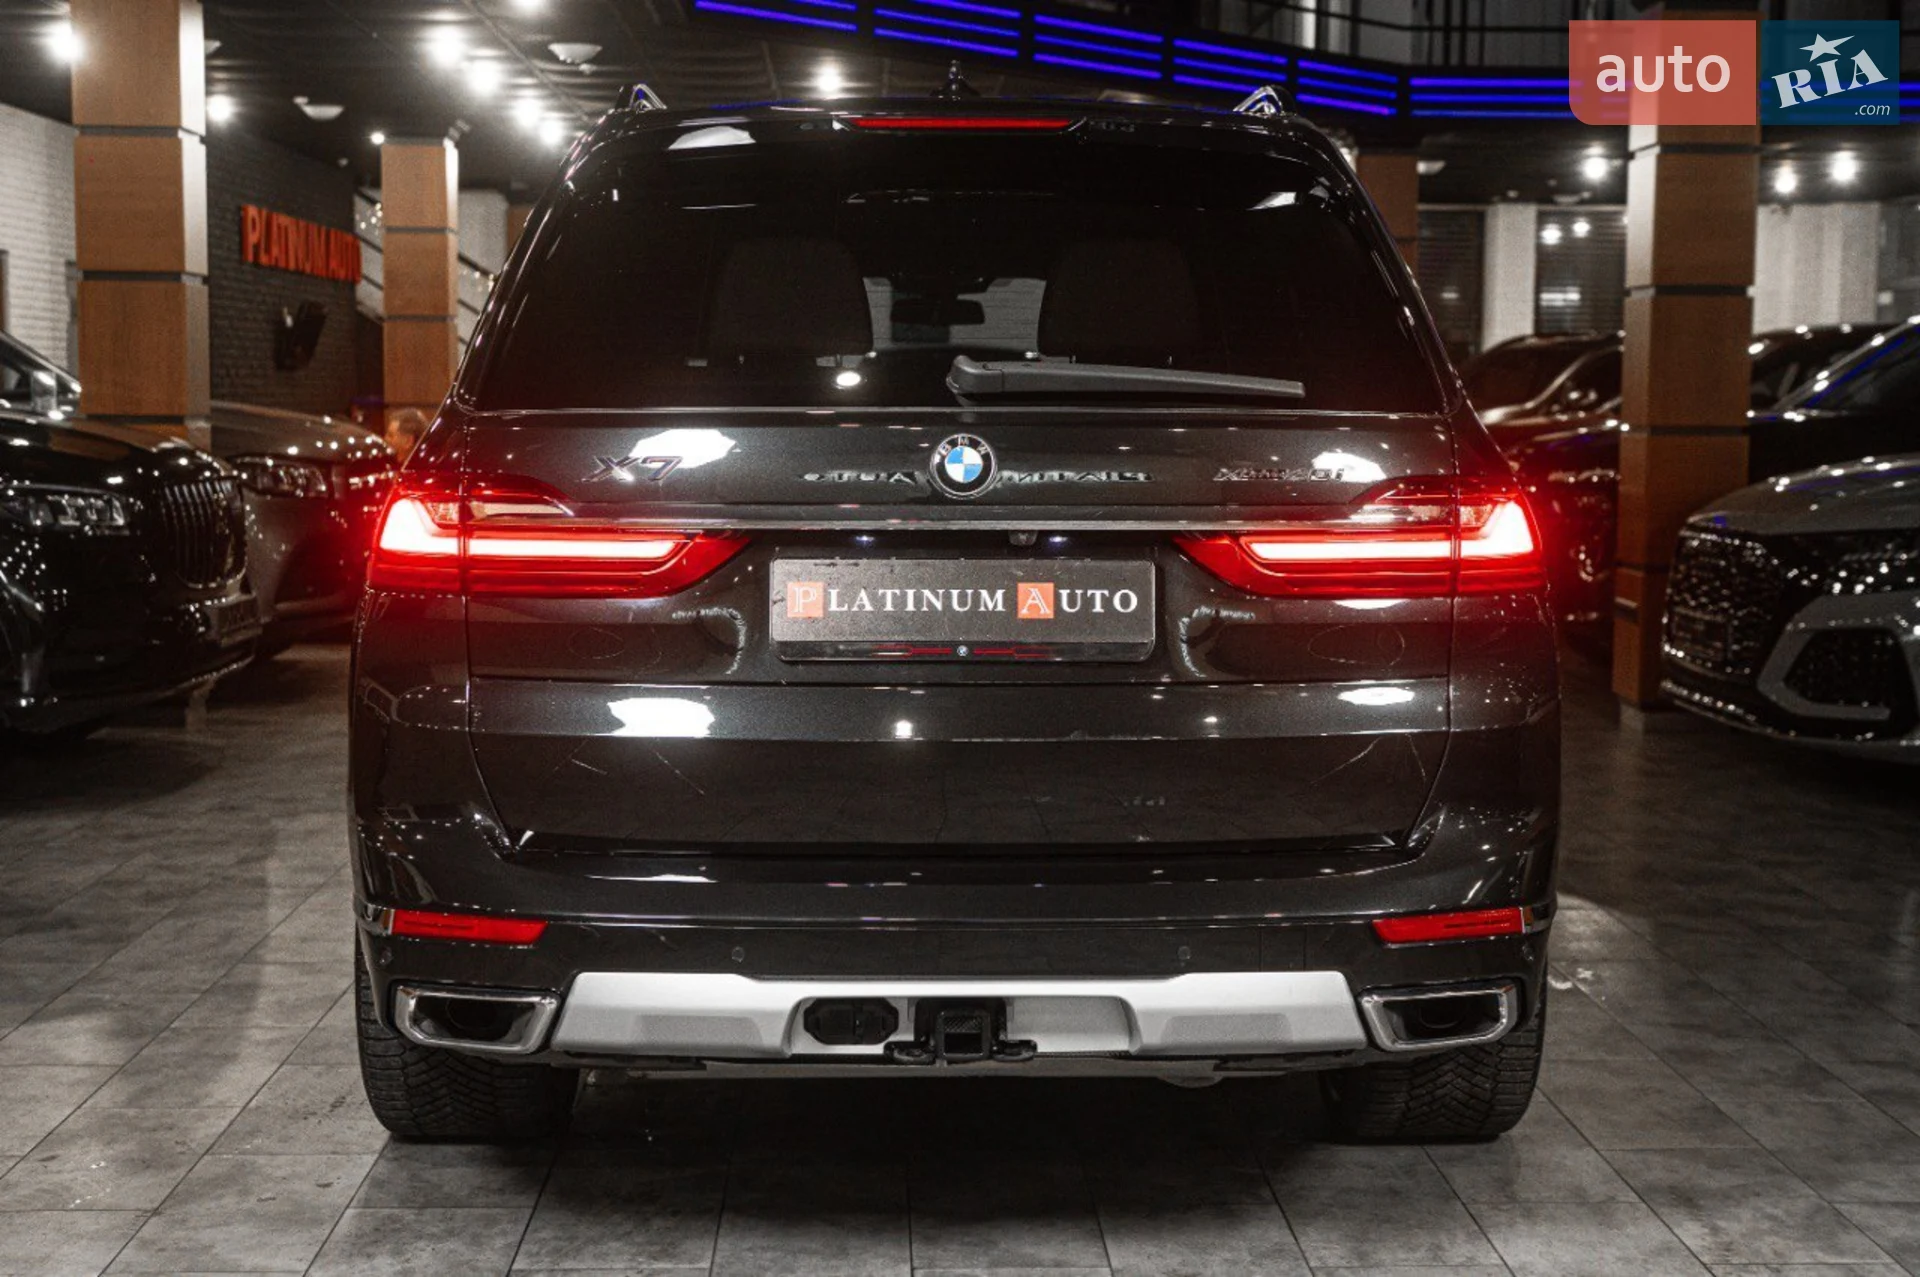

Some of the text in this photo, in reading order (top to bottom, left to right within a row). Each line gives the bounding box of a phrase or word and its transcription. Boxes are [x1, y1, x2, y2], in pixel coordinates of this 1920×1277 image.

[241, 204, 327, 278] PLATINUM
[939, 433, 989, 457] BMW
[581, 455, 684, 483] X7
[792, 586, 1138, 614] PLATINUM AUTO
